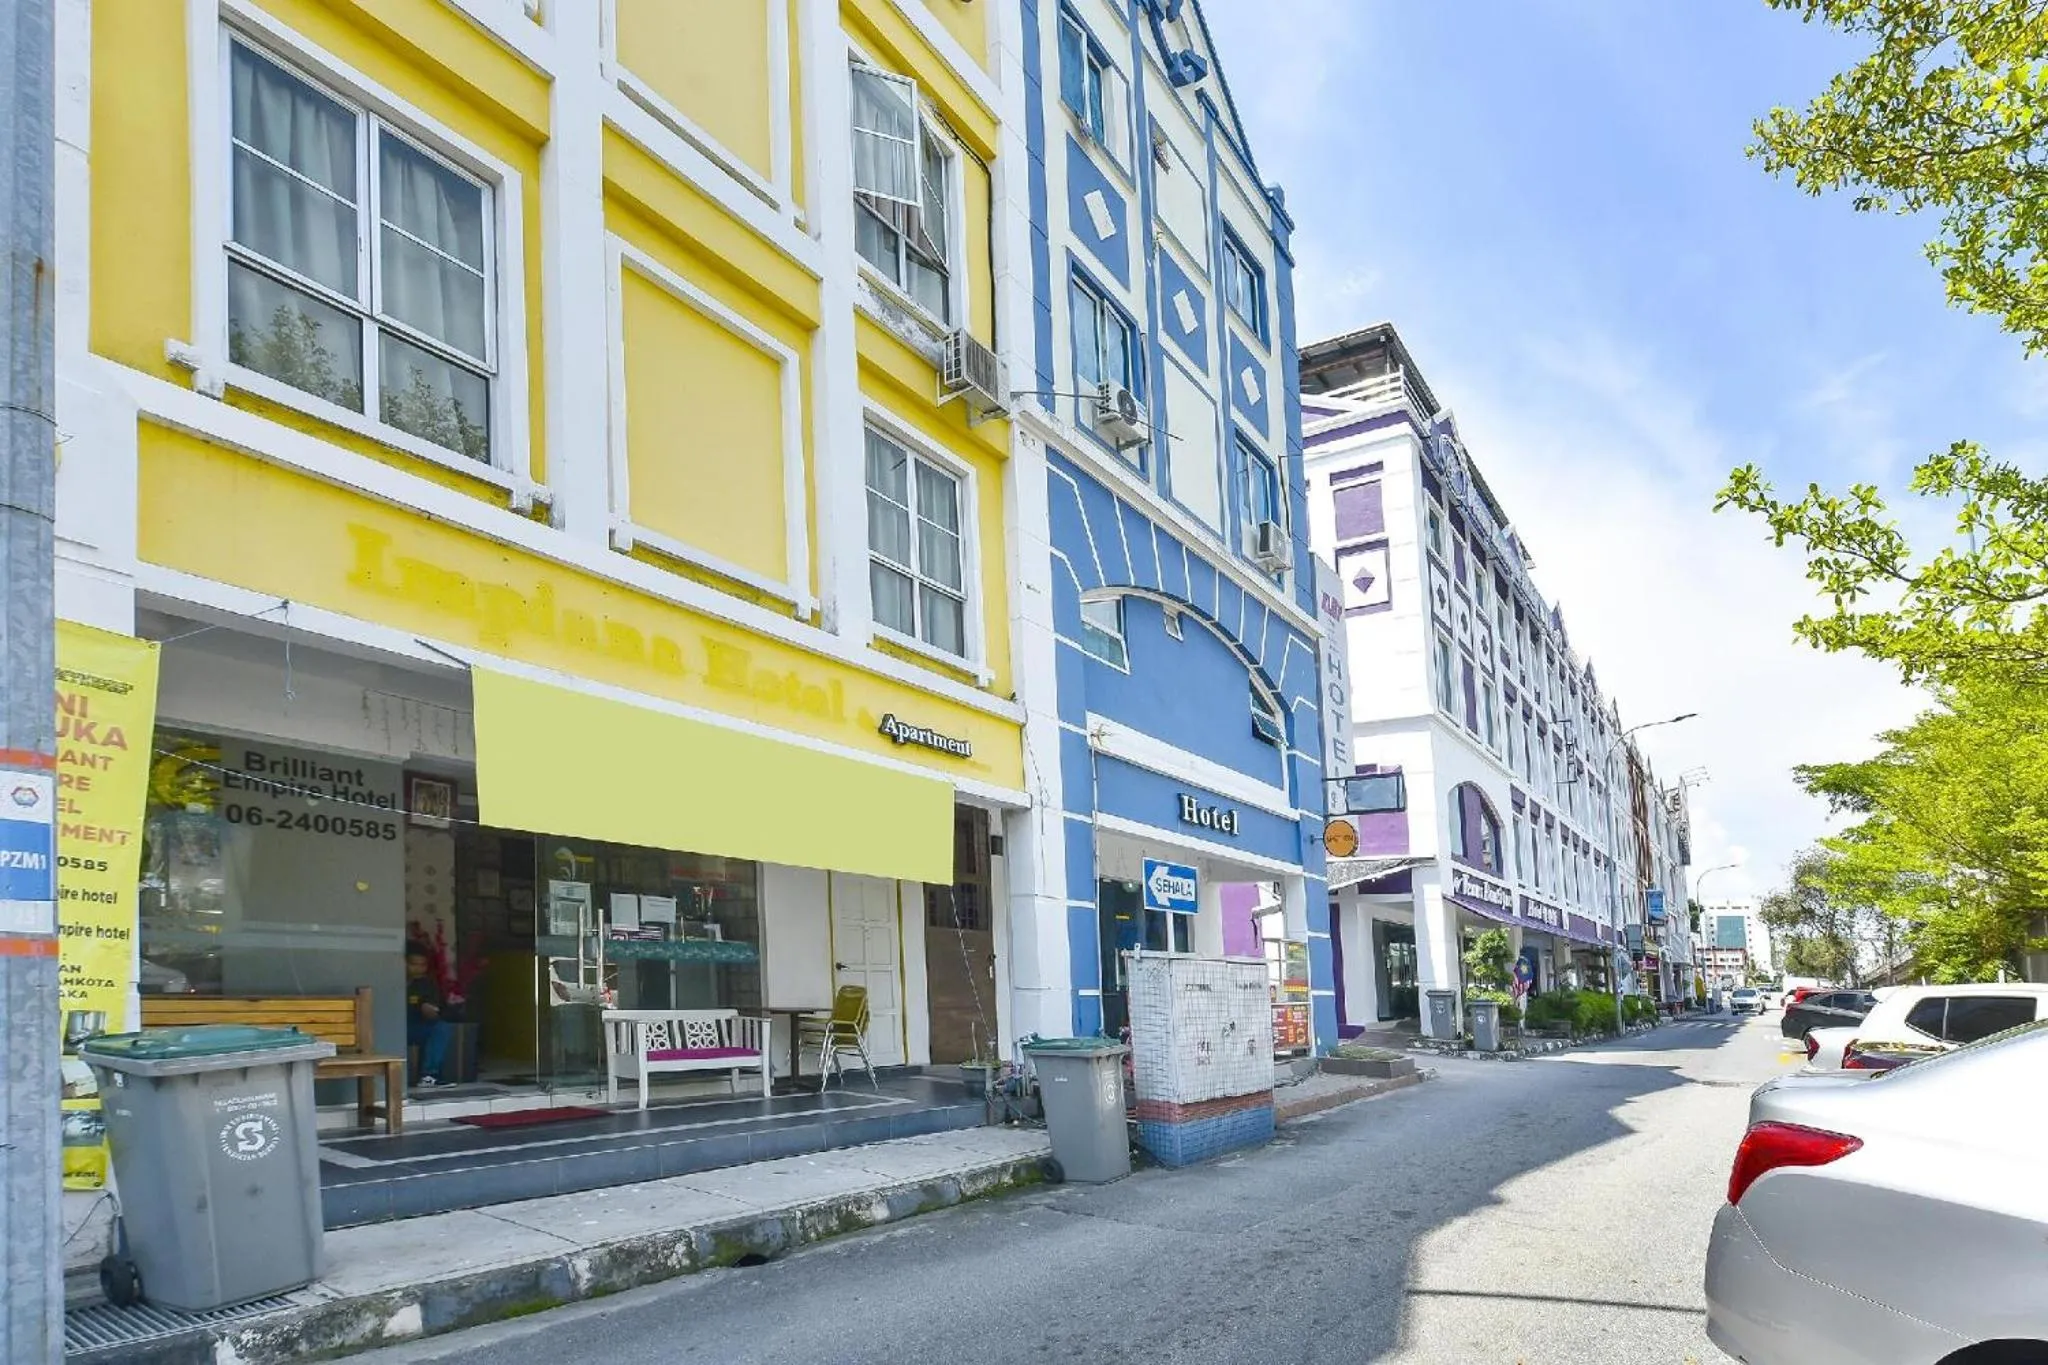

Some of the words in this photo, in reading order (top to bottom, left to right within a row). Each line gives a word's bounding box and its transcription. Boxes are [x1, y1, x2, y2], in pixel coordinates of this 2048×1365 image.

[701, 635, 847, 724] Hotel
[881, 714, 972, 757] Apartment
[244, 751, 364, 787] Brilliant
[223, 769, 323, 799] Empire
[332, 782, 396, 810] Hotel
[225, 805, 397, 840] 06-2400585
[1179, 794, 1240, 836] Hotel
[81, 888, 118, 904] hotel
[1155, 878, 1194, 897] SEHALA
[96, 924, 130, 940] hotel
[60, 977, 115, 988] HKOTA
